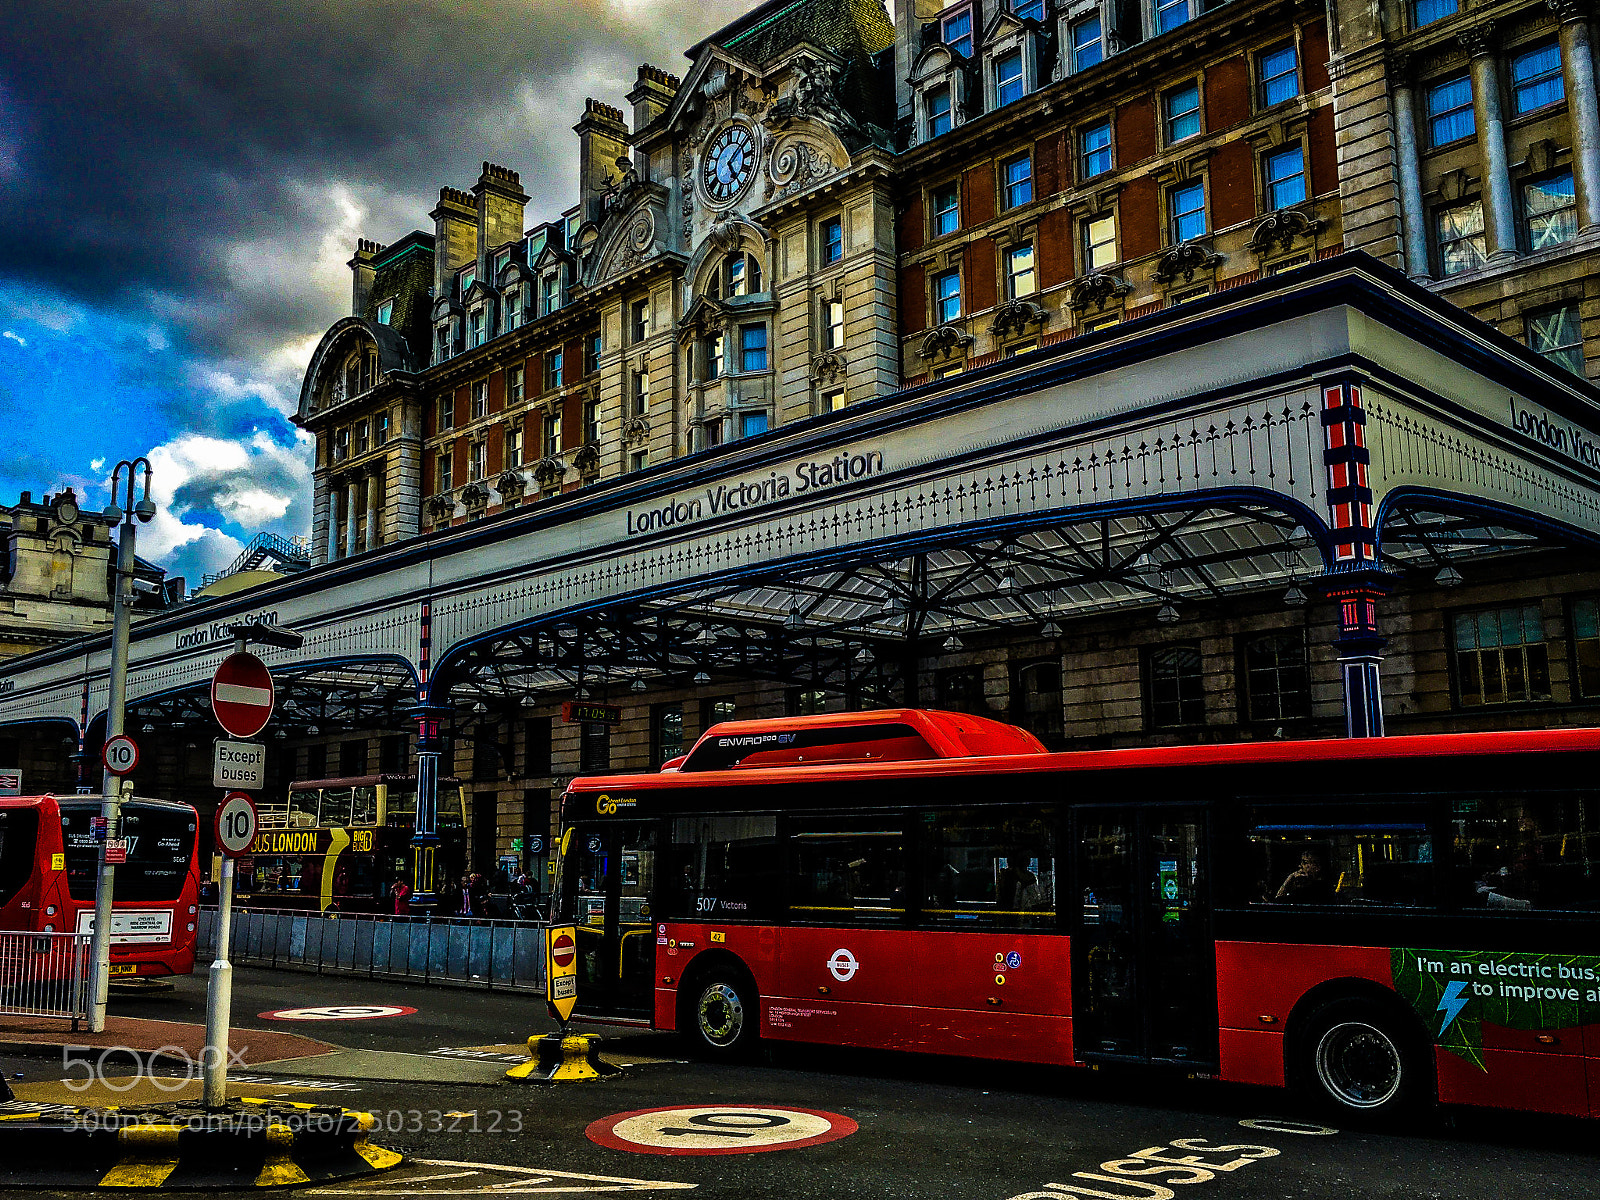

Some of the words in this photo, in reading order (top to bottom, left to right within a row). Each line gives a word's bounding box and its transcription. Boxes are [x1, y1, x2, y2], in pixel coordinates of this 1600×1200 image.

[1509, 396, 1569, 453] London
[627, 498, 702, 536] London
[707, 471, 790, 515] Victoria
[795, 449, 883, 492] Station
[175, 627, 207, 649] London
[209, 618, 243, 640] Victo
[111, 746, 131, 764] 10
[219, 748, 261, 766] Except
[221, 767, 258, 782] buses
[225, 811, 250, 840] 10
[126, 836, 139, 854] 07
[272, 832, 317, 852] LONDON
[353, 831, 364, 841] BIG
[697, 897, 717, 911] 507
[720, 900, 747, 910] Victoria
[1417, 957, 1444, 973] I'm
[1450, 959, 1473, 975] an
[1478, 959, 1553, 978] electric
[1558, 963, 1600, 981] bus,
[556, 978, 574, 987] Except
[1472, 982, 1494, 996] to
[1499, 983, 1580, 1002] improve
[657, 1111, 791, 1139] 10
